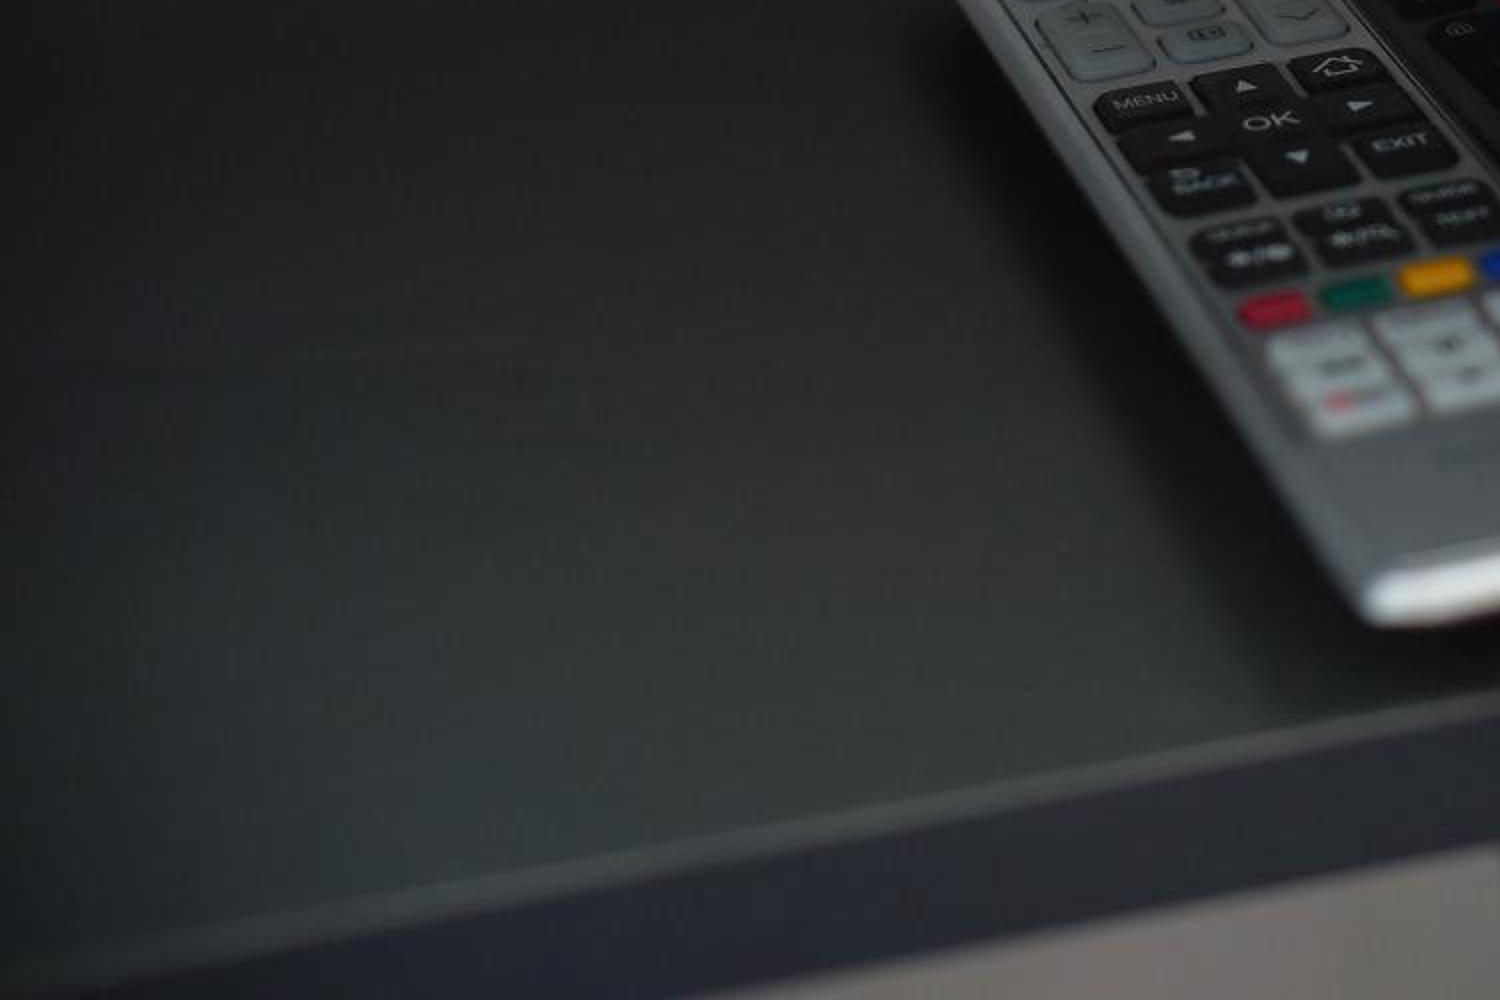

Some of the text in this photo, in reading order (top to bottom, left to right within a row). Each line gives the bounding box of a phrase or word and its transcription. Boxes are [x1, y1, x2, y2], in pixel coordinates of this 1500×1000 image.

[1113, 89, 1180, 112] MENU
[1241, 108, 1300, 132] OK
[1371, 130, 1429, 154] EXIT
